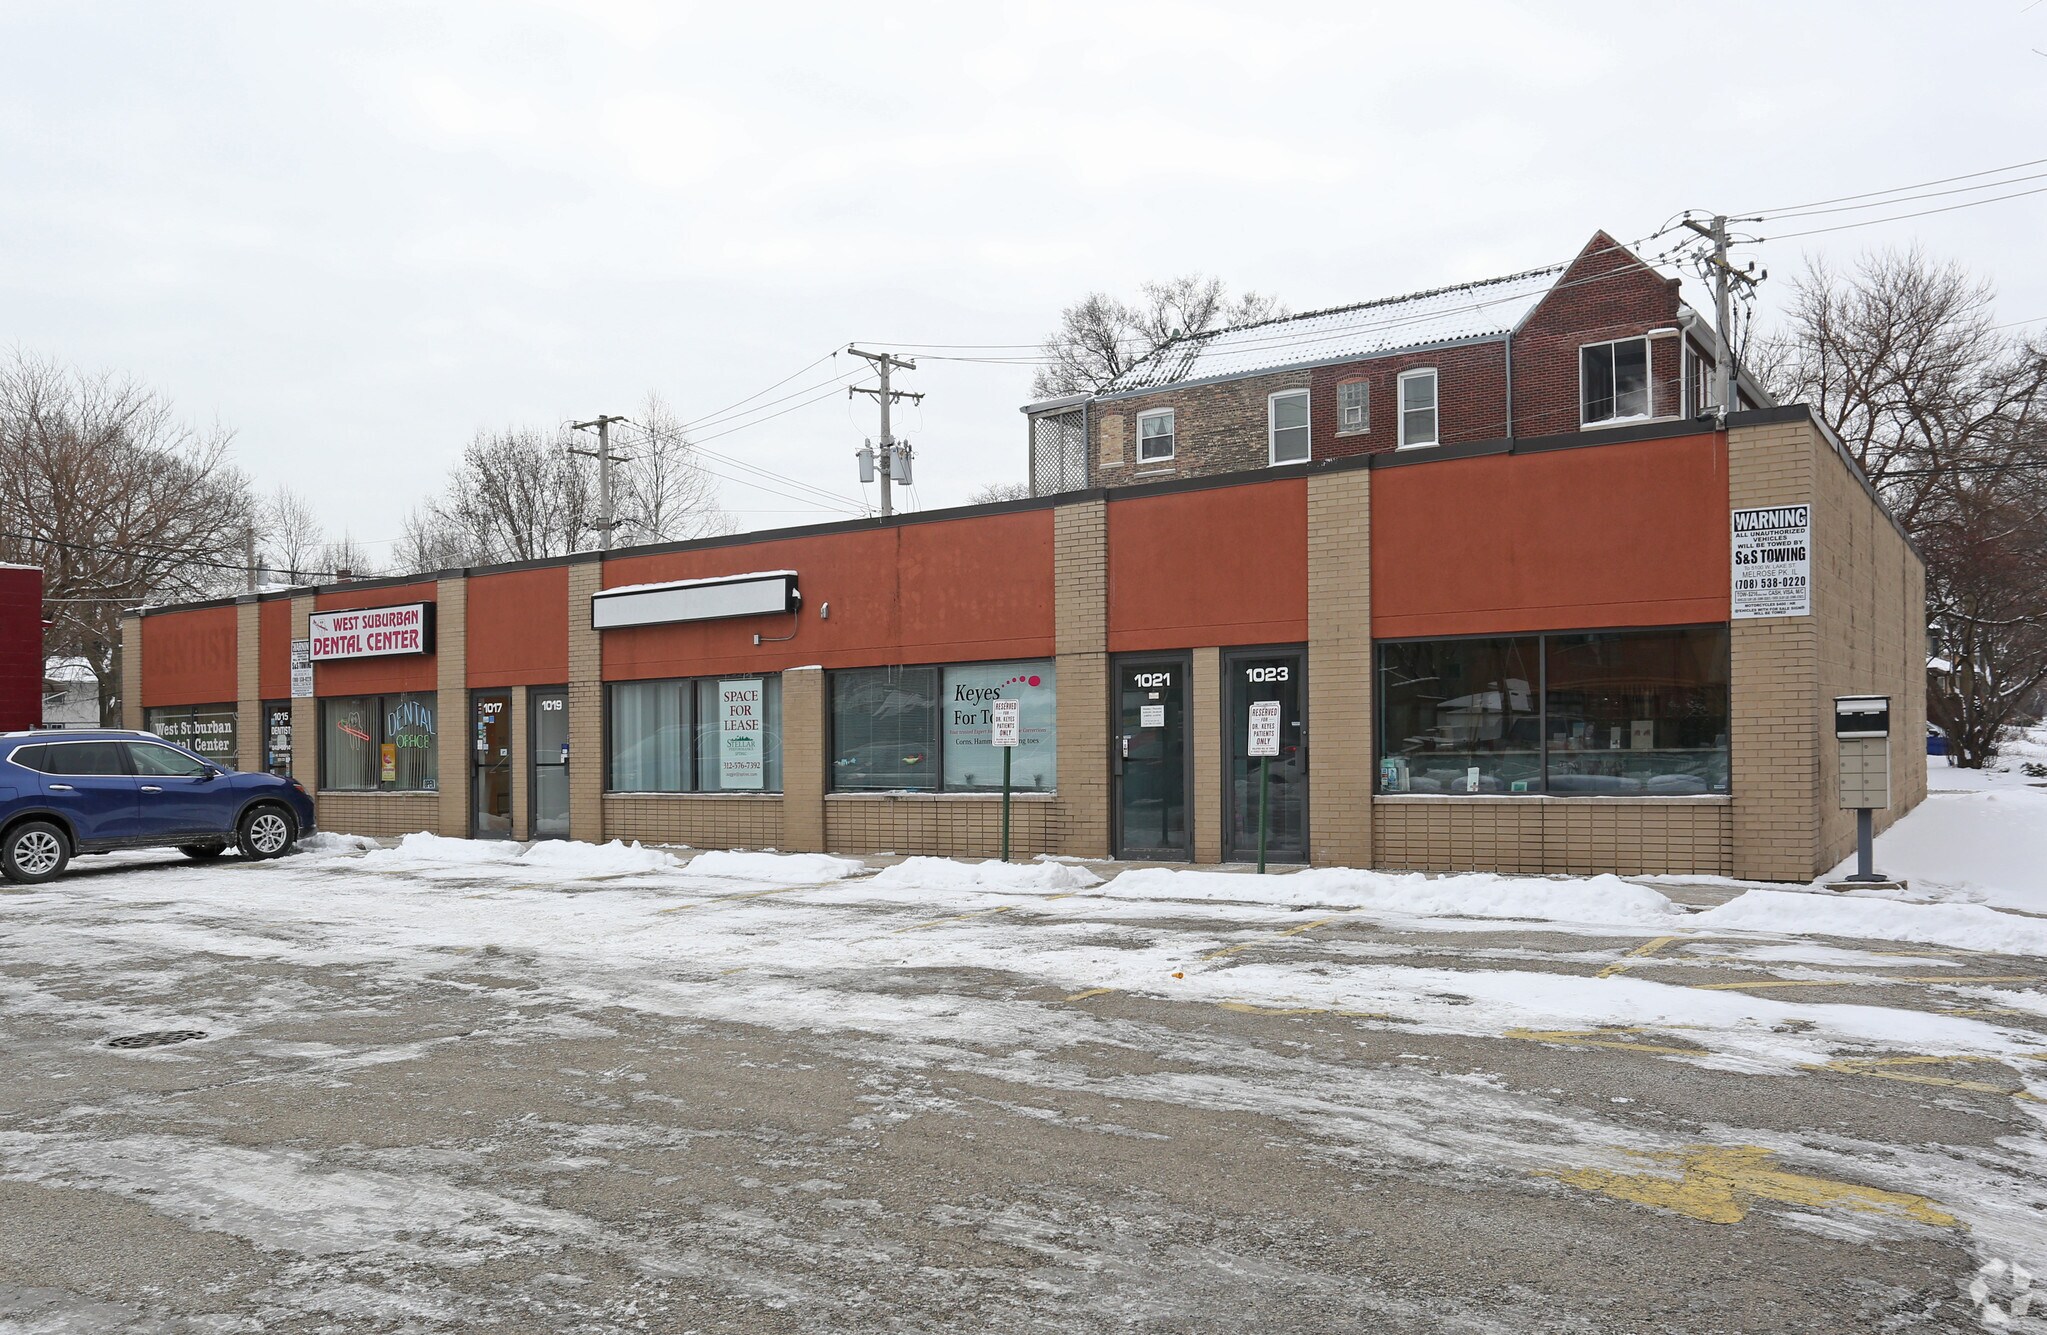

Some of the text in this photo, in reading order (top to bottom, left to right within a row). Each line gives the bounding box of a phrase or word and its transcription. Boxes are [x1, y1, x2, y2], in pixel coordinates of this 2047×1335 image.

[1735, 508, 1807, 531] WARNING
[1750, 528, 1806, 537] UNAUTHORIZED
[1735, 547, 1806, 565] S&S TOWING
[1742, 570, 1776, 578] MELROSE
[1735, 576, 1806, 590] (708) 538-0220
[333, 610, 419, 632] WEST SUBURBAN
[313, 635, 363, 656] DENTAL
[366, 629, 419, 651] CENTER
[1133, 672, 1171, 688] 1021
[1246, 667, 1289, 683] 1023
[723, 690, 758, 702] SPACE
[955, 684, 1001, 706] Keyes
[483, 702, 503, 713] 1017
[541, 700, 563, 711] 1019
[730, 705, 752, 717] FOR
[995, 702, 1016, 710] RESERVED
[273, 712, 289, 721] 1015
[954, 710, 977, 725] For
[1252, 707, 1277, 717] RESERVED
[388, 701, 437, 737] DENTAL
[724, 719, 759, 731] LEASE
[155, 721, 233, 736] West Suburban
[271, 726, 291, 735] DENTIST
[194, 738, 230, 752] Center
[727, 739, 756, 748] STELLAR
[1256, 737, 1271, 745] ONLY
[723, 761, 761, 769] 312-576-7392
